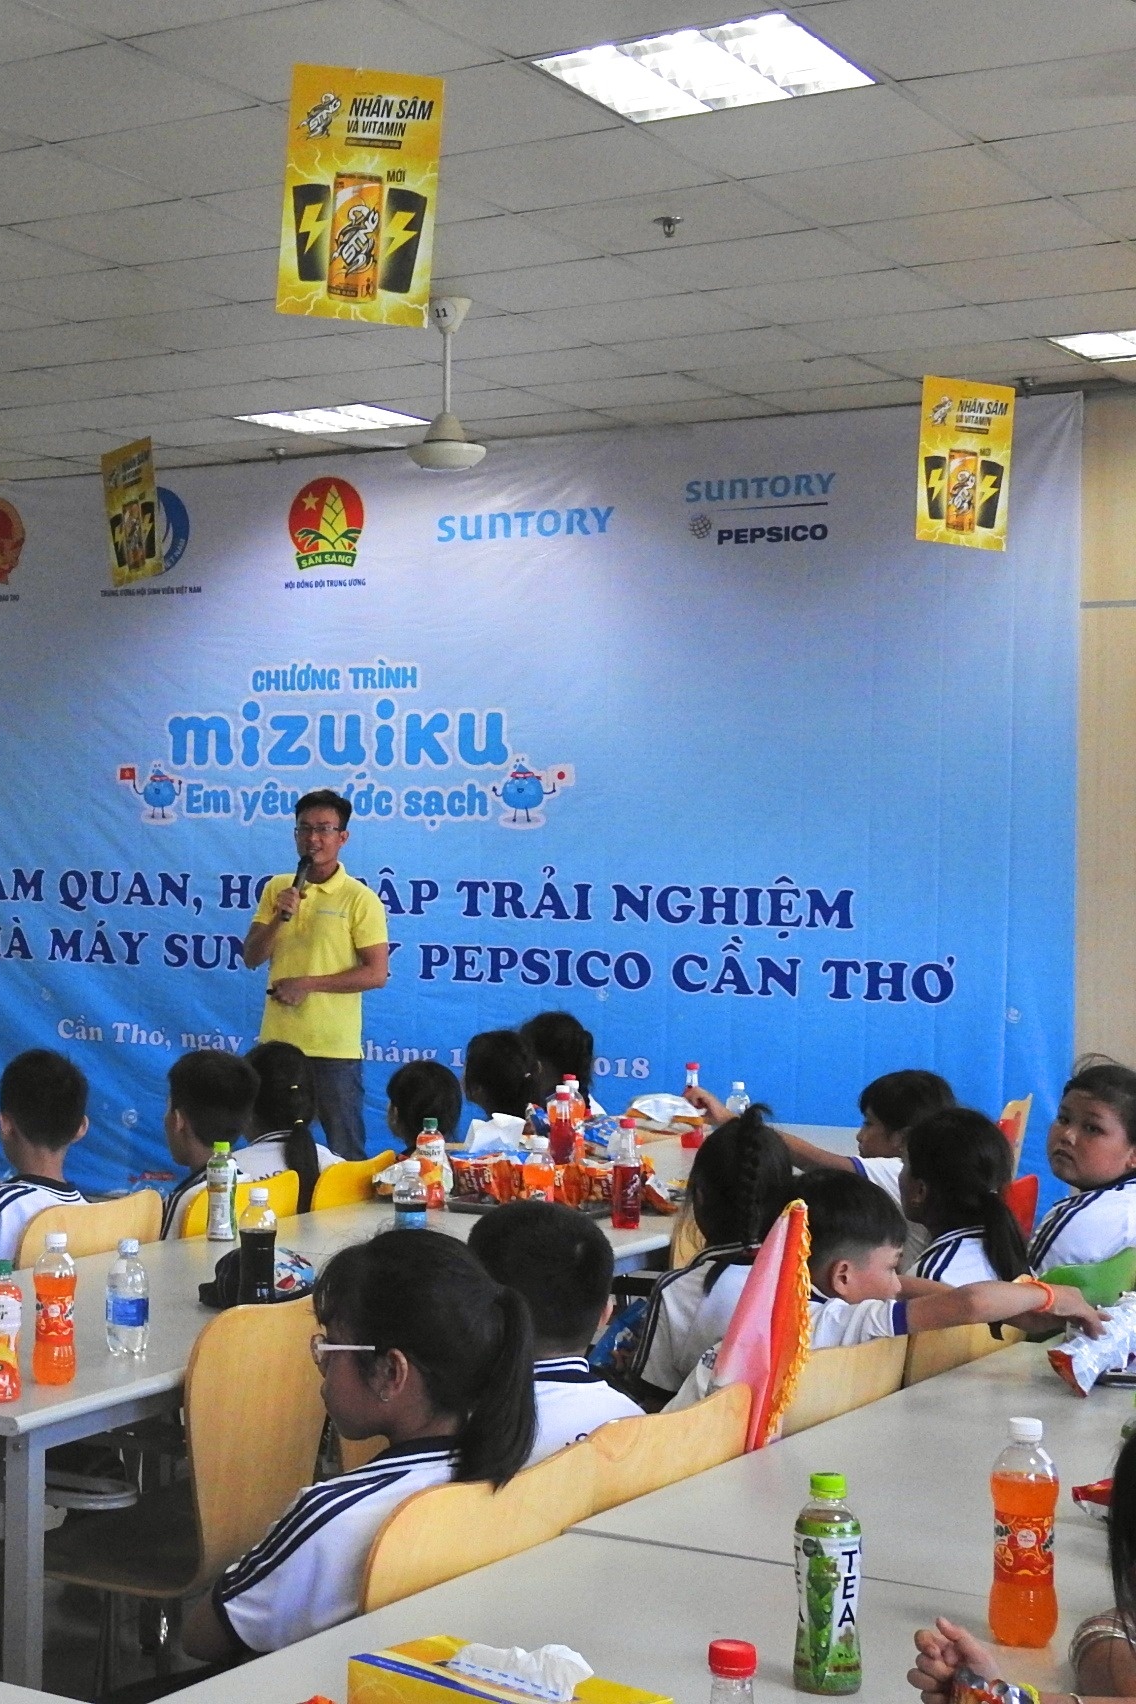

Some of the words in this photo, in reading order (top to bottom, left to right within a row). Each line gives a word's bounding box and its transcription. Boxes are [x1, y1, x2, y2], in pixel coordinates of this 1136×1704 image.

[349, 94, 394, 119] NHÂN
[398, 96, 435, 121] SÂM
[362, 122, 406, 137] VITAMIN
[435, 308, 449, 318] 11
[717, 523, 829, 545] PEPSICO
[327, 579, 347, 588] TRUNG
[349, 660, 417, 690] TRÌNH
[169, 699, 510, 768] mizuiku
[185, 790, 231, 816] Em
[403, 783, 489, 827] sạch
[59, 869, 203, 916] QUAN,
[457, 865, 592, 921] TRẢI
[612, 876, 854, 939] NGHIỆM
[50, 922, 149, 966] MÁY
[419, 942, 652, 991] PEPSICO
[672, 935, 801, 998] CẦN
[822, 955, 957, 1004] THƠ
[58, 1017, 105, 1042] Cần
[180, 1028, 244, 1055] ngày
[593, 1056, 651, 1081] 018
[838, 1550, 858, 1628] TEA
